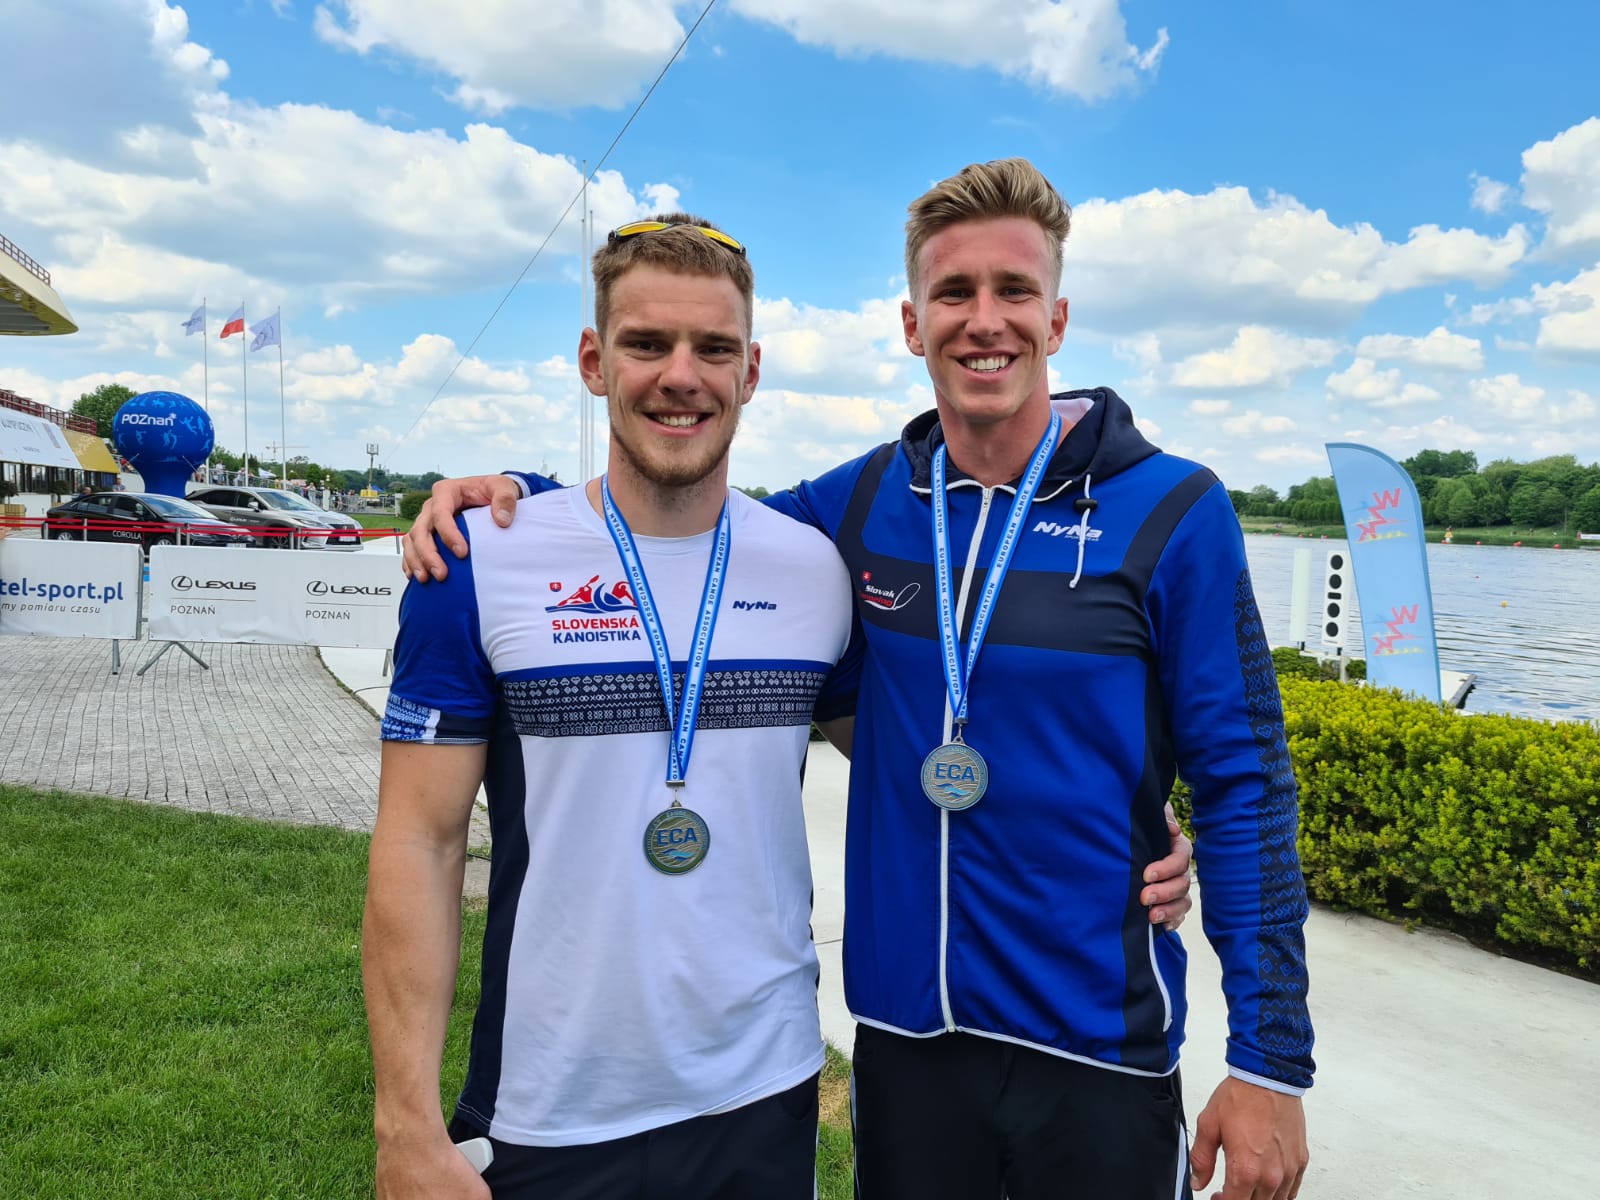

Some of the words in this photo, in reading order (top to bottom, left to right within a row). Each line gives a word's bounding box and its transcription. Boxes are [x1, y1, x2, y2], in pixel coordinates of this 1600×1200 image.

[935, 479, 944, 535] ASSOCIATION
[1014, 489, 1030, 518] CANOE
[194, 579, 257, 591] LEXUS
[330, 585, 392, 596] LEXUS
[631, 566, 656, 624] ASSOCIATION
[706, 577, 719, 606] CANOE
[865, 584, 896, 599] Slovak
[20, 602, 66, 612] pomiaru
[70, 605, 102, 614] czasu
[170, 605, 216, 615] POZNAŃ
[305, 609, 351, 620] POZNAŃ
[732, 600, 778, 611] NyNa
[941, 598, 952, 629] CANOE
[552, 614, 640, 631] SLOVENSKÁ
[552, 630, 642, 644] KANOISTIKA
[694, 609, 712, 668] ASSOCIATION
[944, 634, 961, 696] ASSOCIATION
[681, 683, 696, 732] EUROPEAN
[935, 762, 976, 783] ECA
[656, 827, 698, 847] ECA
